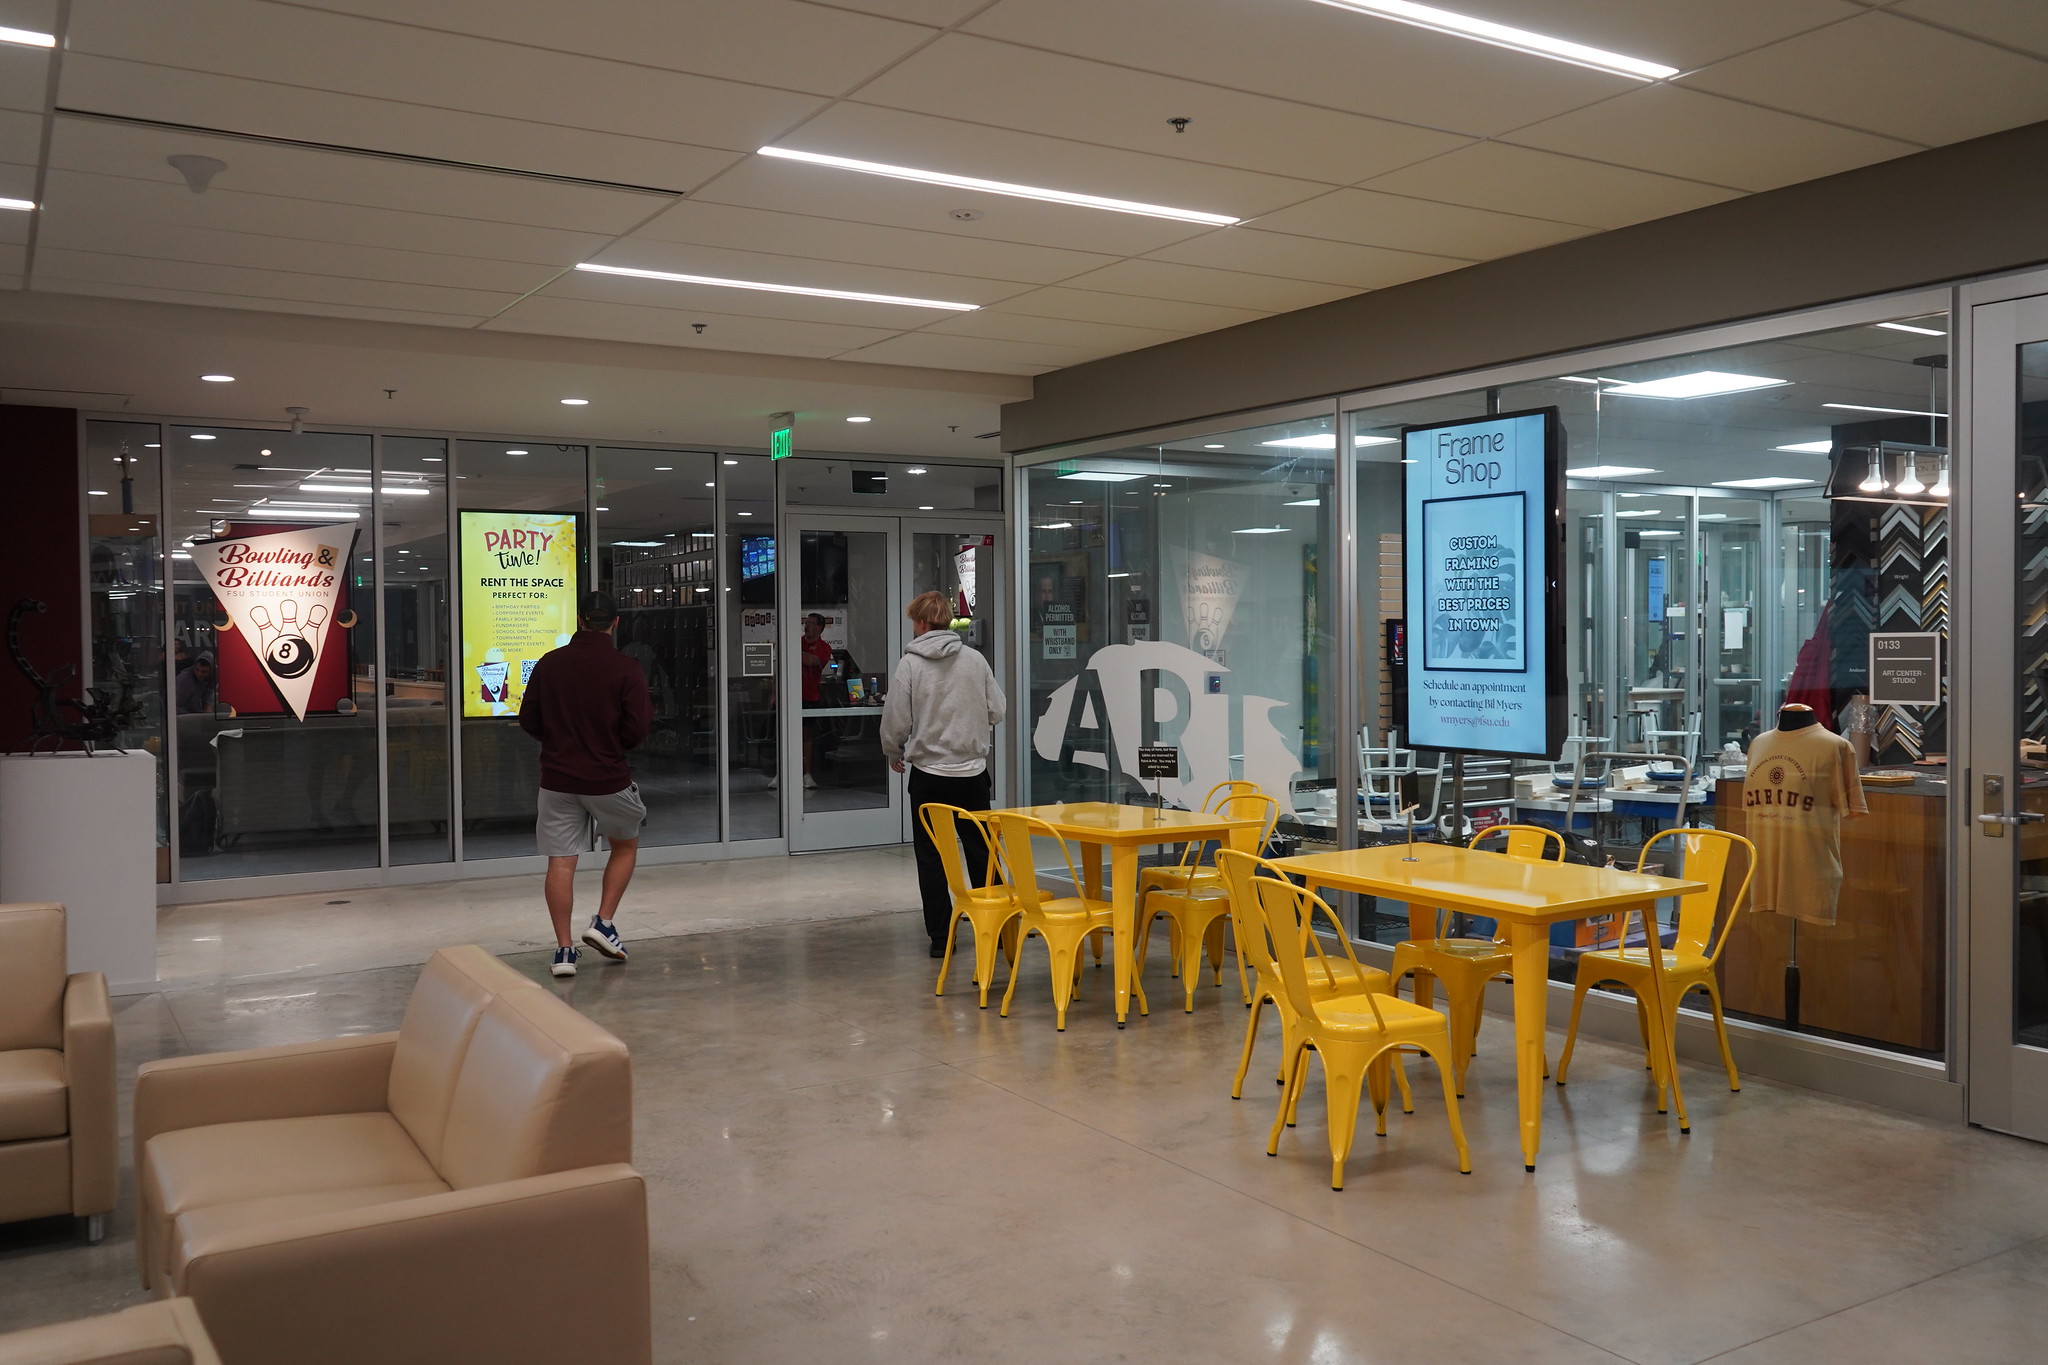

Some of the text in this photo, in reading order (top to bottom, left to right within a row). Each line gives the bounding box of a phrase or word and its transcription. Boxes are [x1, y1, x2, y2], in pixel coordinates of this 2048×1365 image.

[1438, 433, 1505, 458] Frame
[1446, 458, 1502, 489] Shop
[484, 529, 553, 551] PARTY
[1449, 535, 1497, 551] CUSTOM
[218, 543, 335, 570] Bowling &
[494, 549, 541, 569] time!
[1445, 556, 1499, 571] FRAMING
[216, 567, 335, 588] Billiards
[480, 578, 564, 588] RENT THE SPACE
[1445, 577, 1499, 591] WITH THE
[1048, 604, 1072, 613] ALCOHOL
[1438, 597, 1511, 611] BEST PRICES
[1045, 613, 1074, 622] PERMITTED
[1448, 618, 1500, 631] IN TOWN
[1053, 628, 1067, 636] WITH
[1045, 637, 1075, 646] WRISTBAND
[1877, 640, 1901, 650] 0133
[279, 643, 291, 659] 8
[1048, 646, 1062, 655] ONLY
[1423, 679, 1526, 694] Schedule an appointment
[1429, 696, 1438, 708] by
[1440, 698, 1484, 711] contacting
[1496, 700, 1523, 711] Myers
[1058, 668, 1267, 788] ART
[1440, 715, 1510, 727] wmyers@fsu.edu
[1746, 788, 1815, 812] CIRCUS
